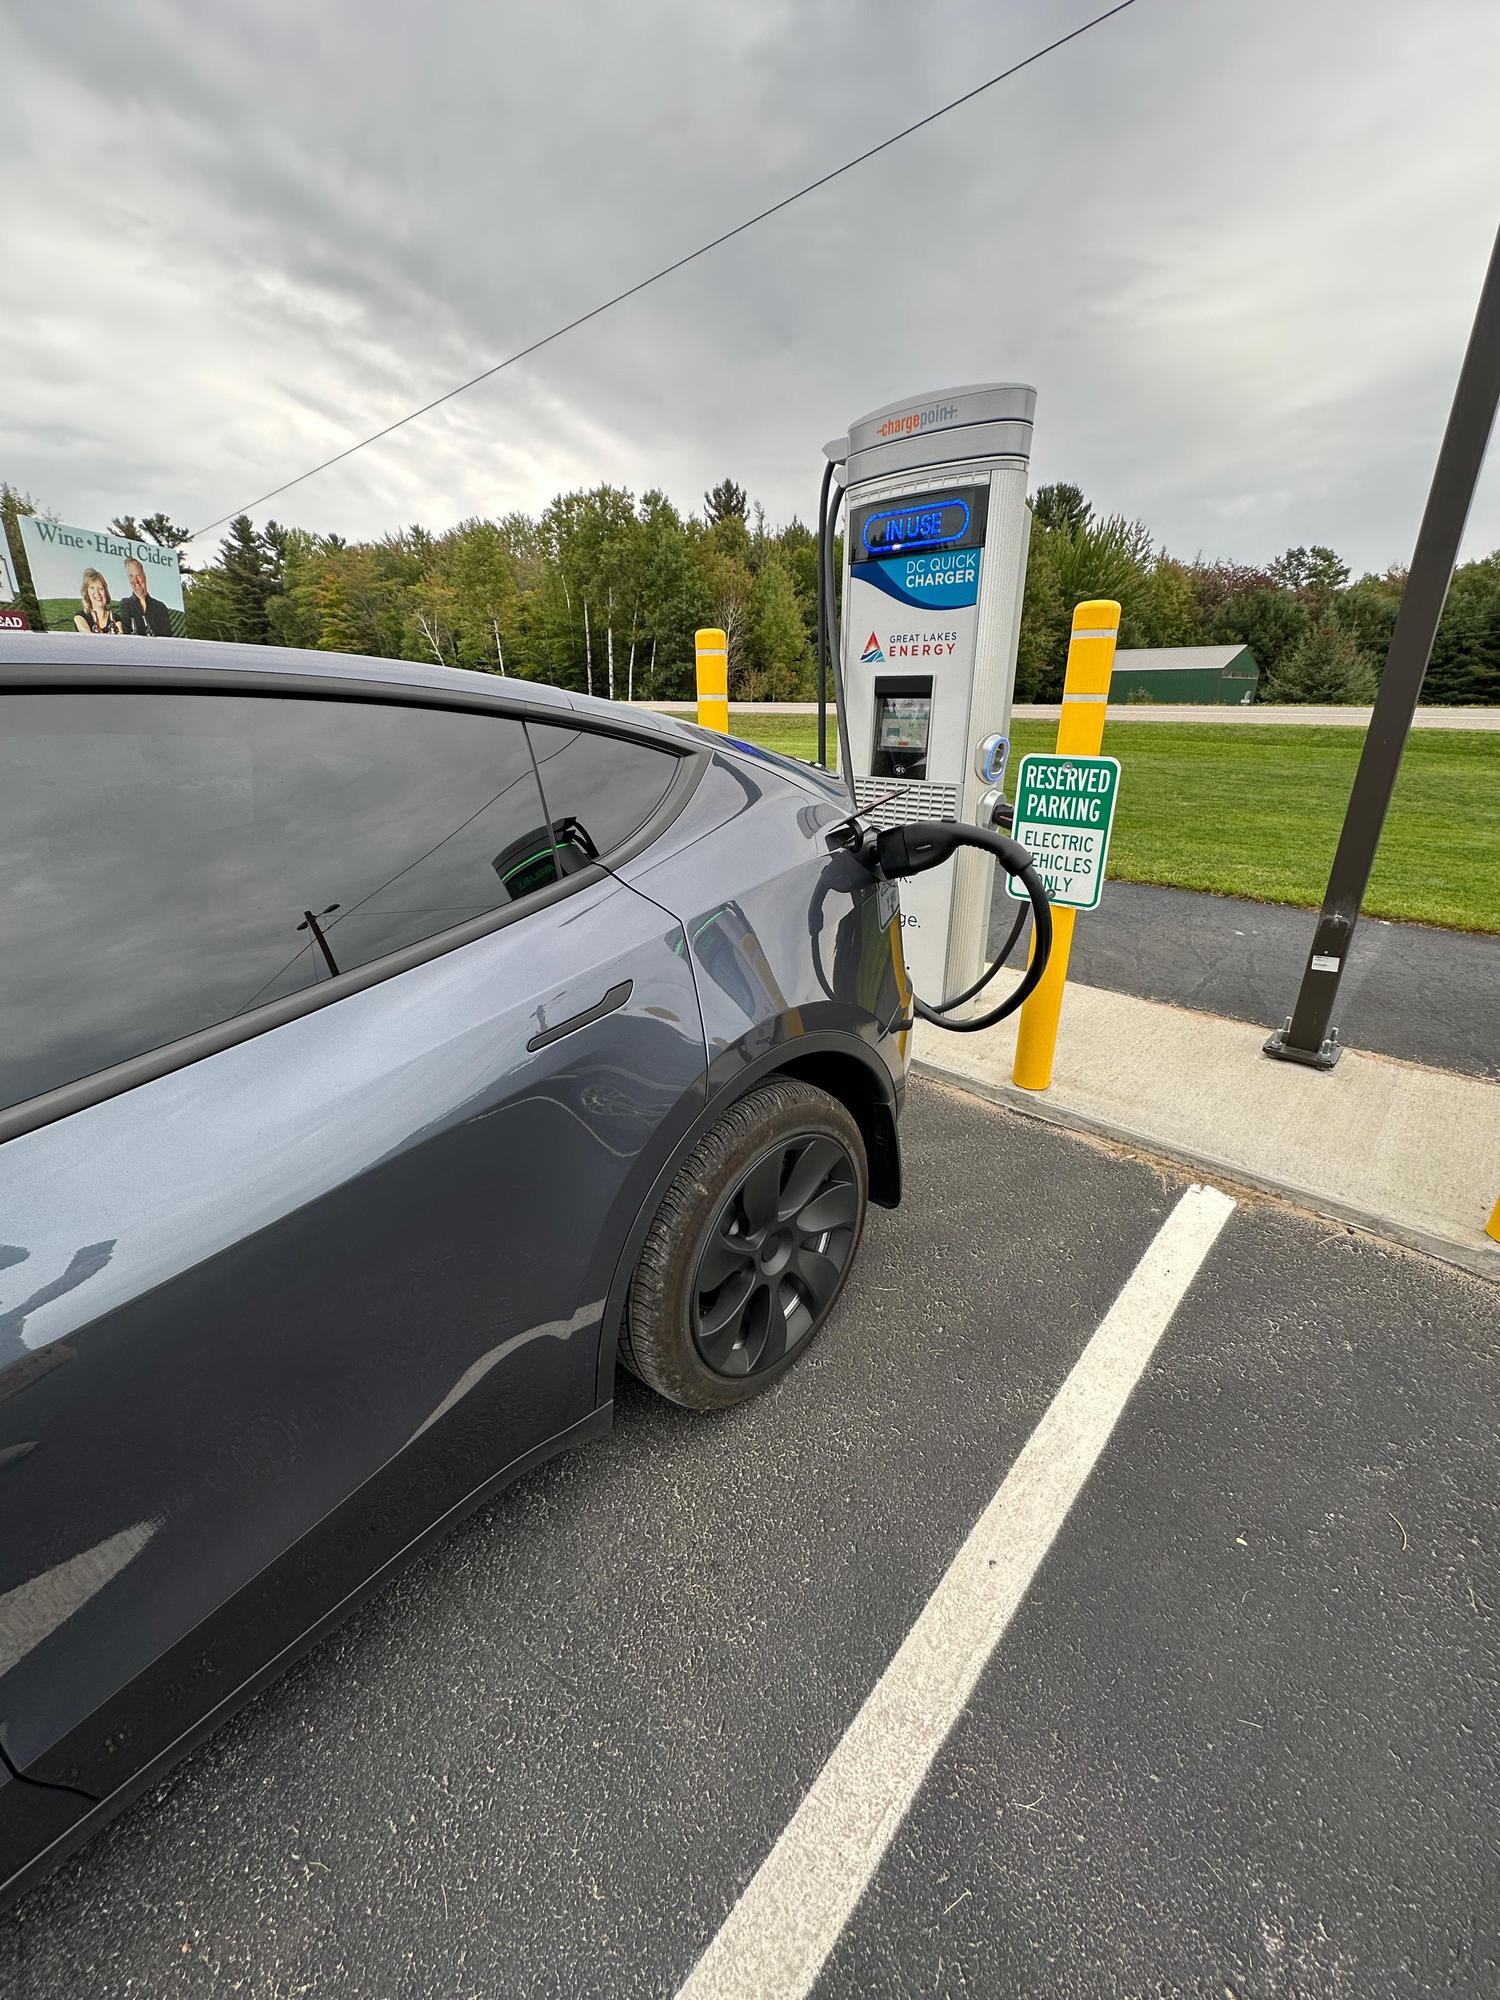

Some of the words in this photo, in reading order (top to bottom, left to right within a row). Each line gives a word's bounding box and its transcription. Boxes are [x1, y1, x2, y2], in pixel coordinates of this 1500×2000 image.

[886, 518, 903, 542] IN
[907, 512, 942, 538] USE
[35, 521, 83, 549] Wine
[94, 534, 132, 559] Hard
[136, 544, 173, 567] Cider
[906, 560, 926, 574] DC
[930, 553, 976, 571] QUICK
[906, 569, 975, 588] CHARGER
[889, 633, 920, 644] GREAT
[923, 632, 957, 642] LAKES
[889, 643, 956, 657] ENERGY
[1025, 765, 1111, 793] RESERVED
[1027, 794, 1102, 822] PARKING
[1025, 830, 1094, 853] ELECTRIC
[1028, 852, 1092, 874] EHICLES
